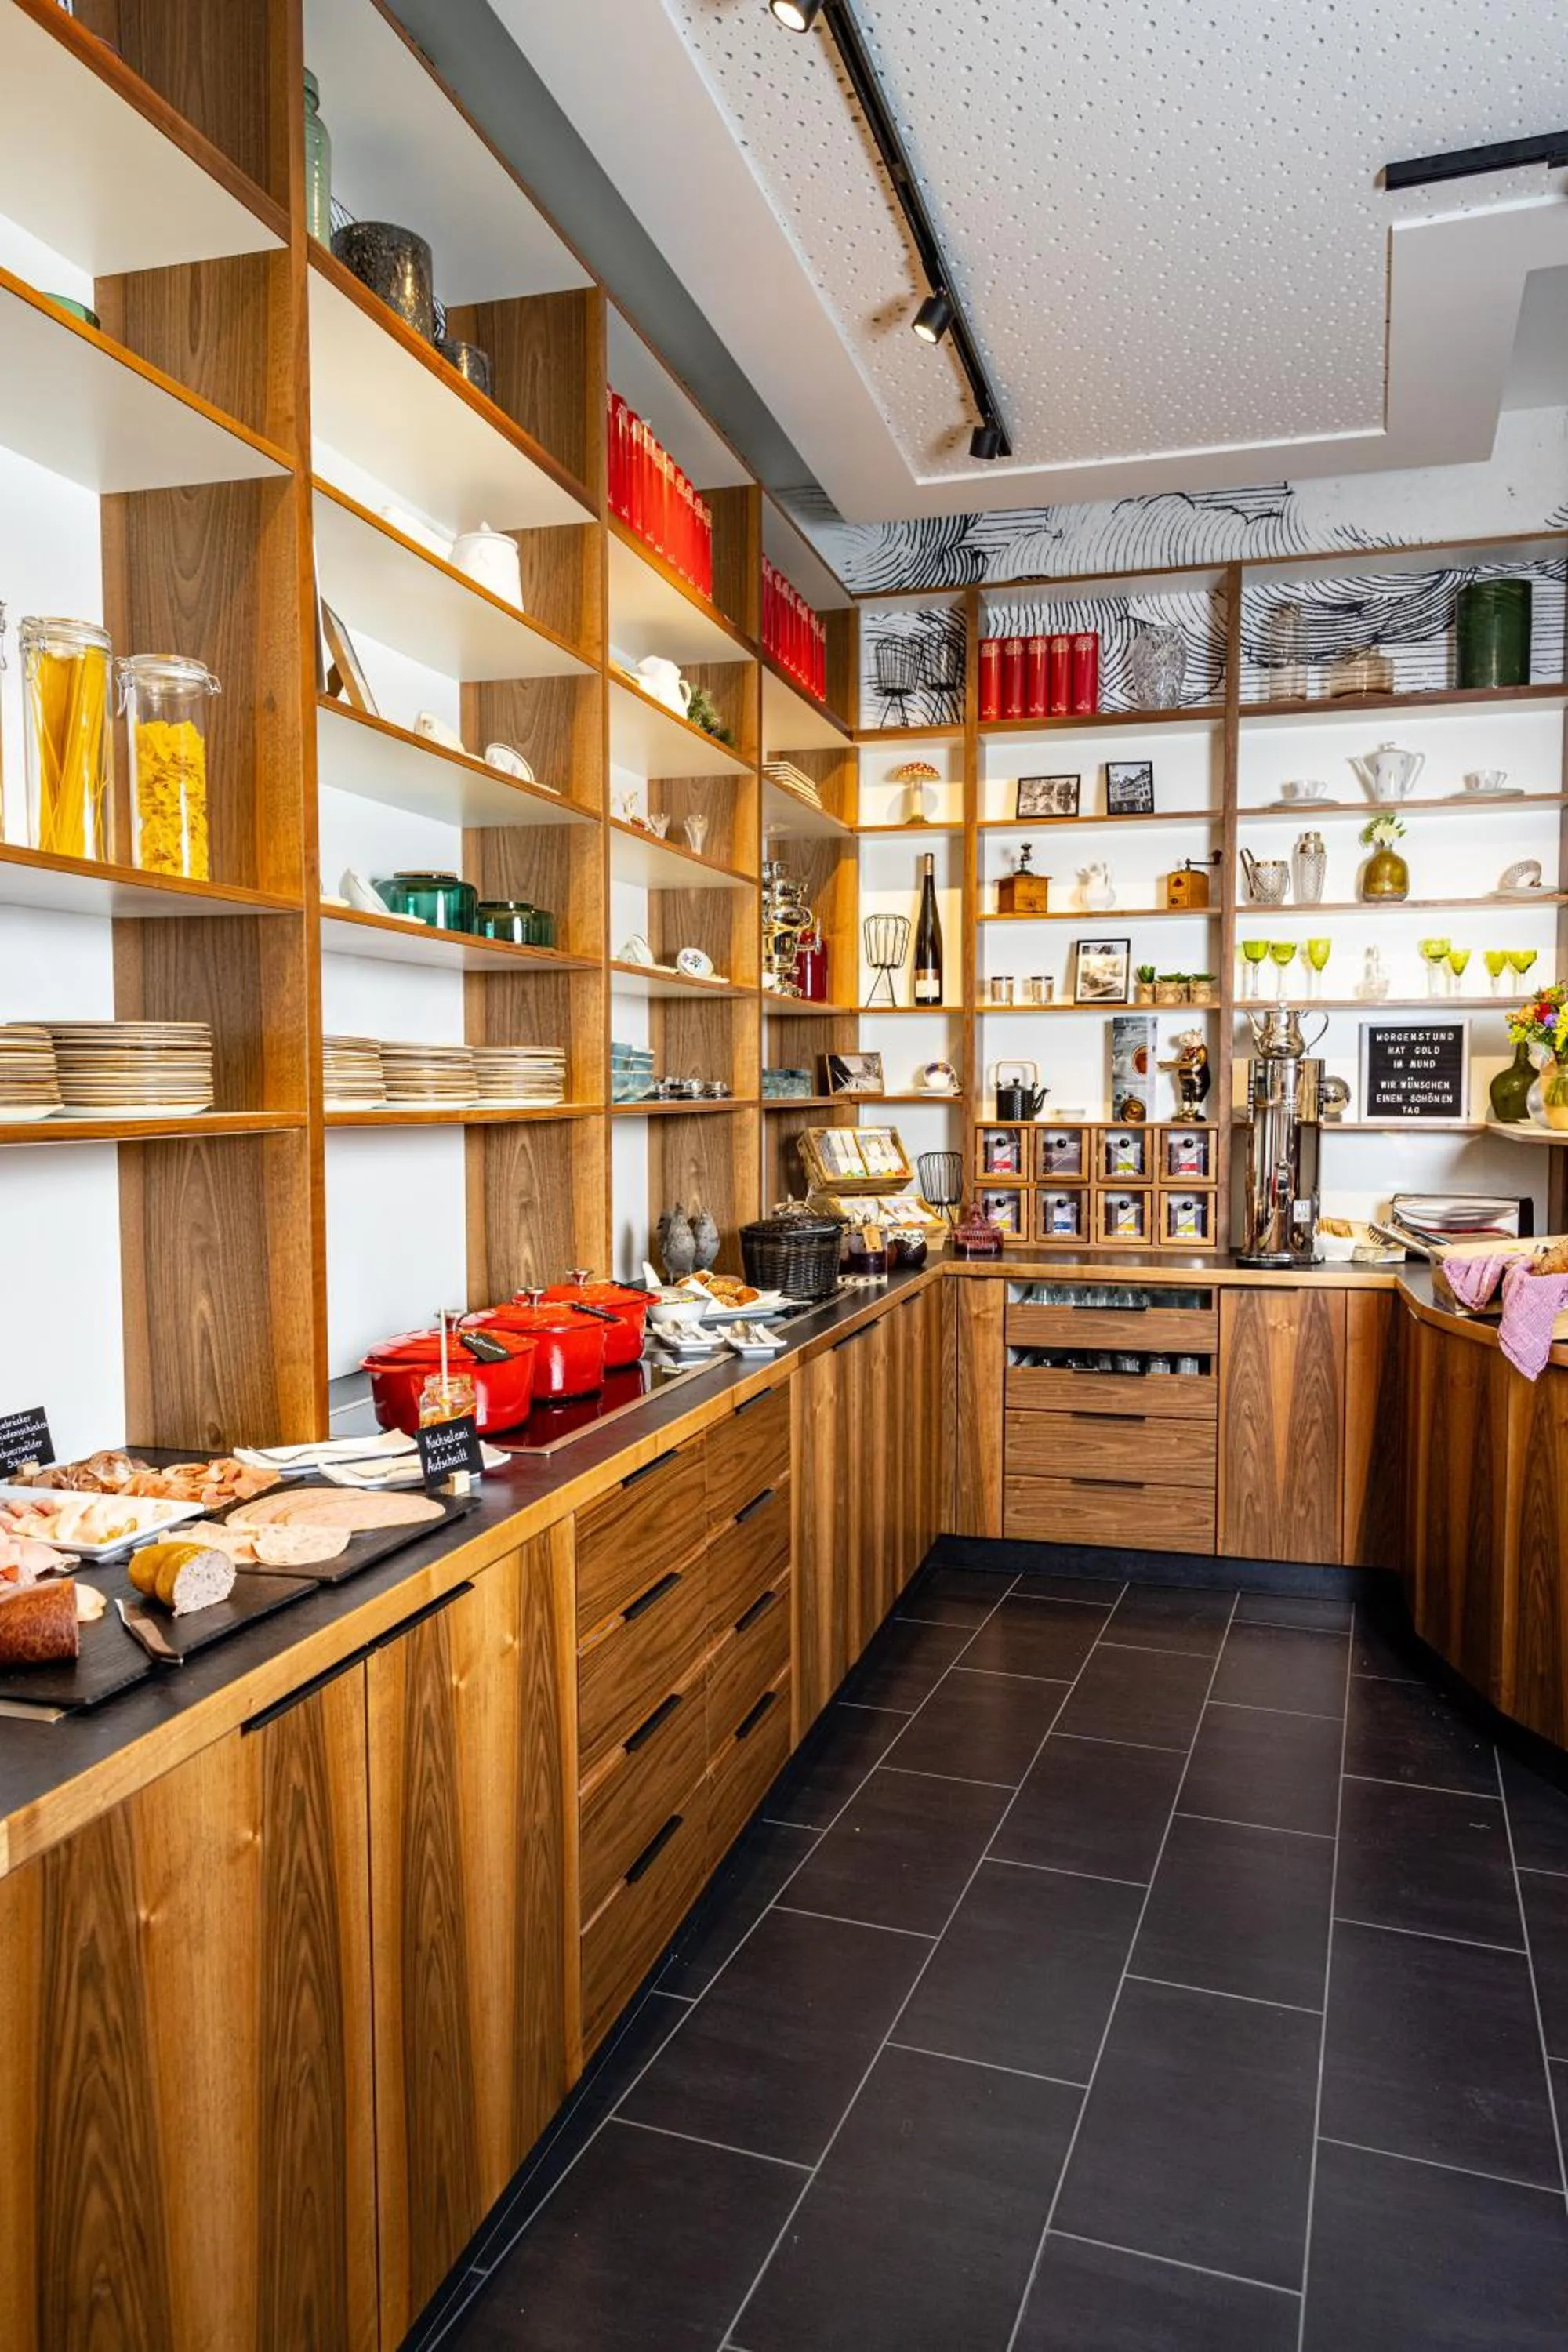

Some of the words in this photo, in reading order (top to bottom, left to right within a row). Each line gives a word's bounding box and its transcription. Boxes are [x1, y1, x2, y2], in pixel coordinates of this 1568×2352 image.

[1414, 1045, 1440, 1054] GOLD
[1393, 1059, 1403, 1069] IM
[1410, 1059, 1436, 1069] MUND
[1380, 1081, 1396, 1090] WIR
[1376, 1094, 1403, 1103] EINEN
